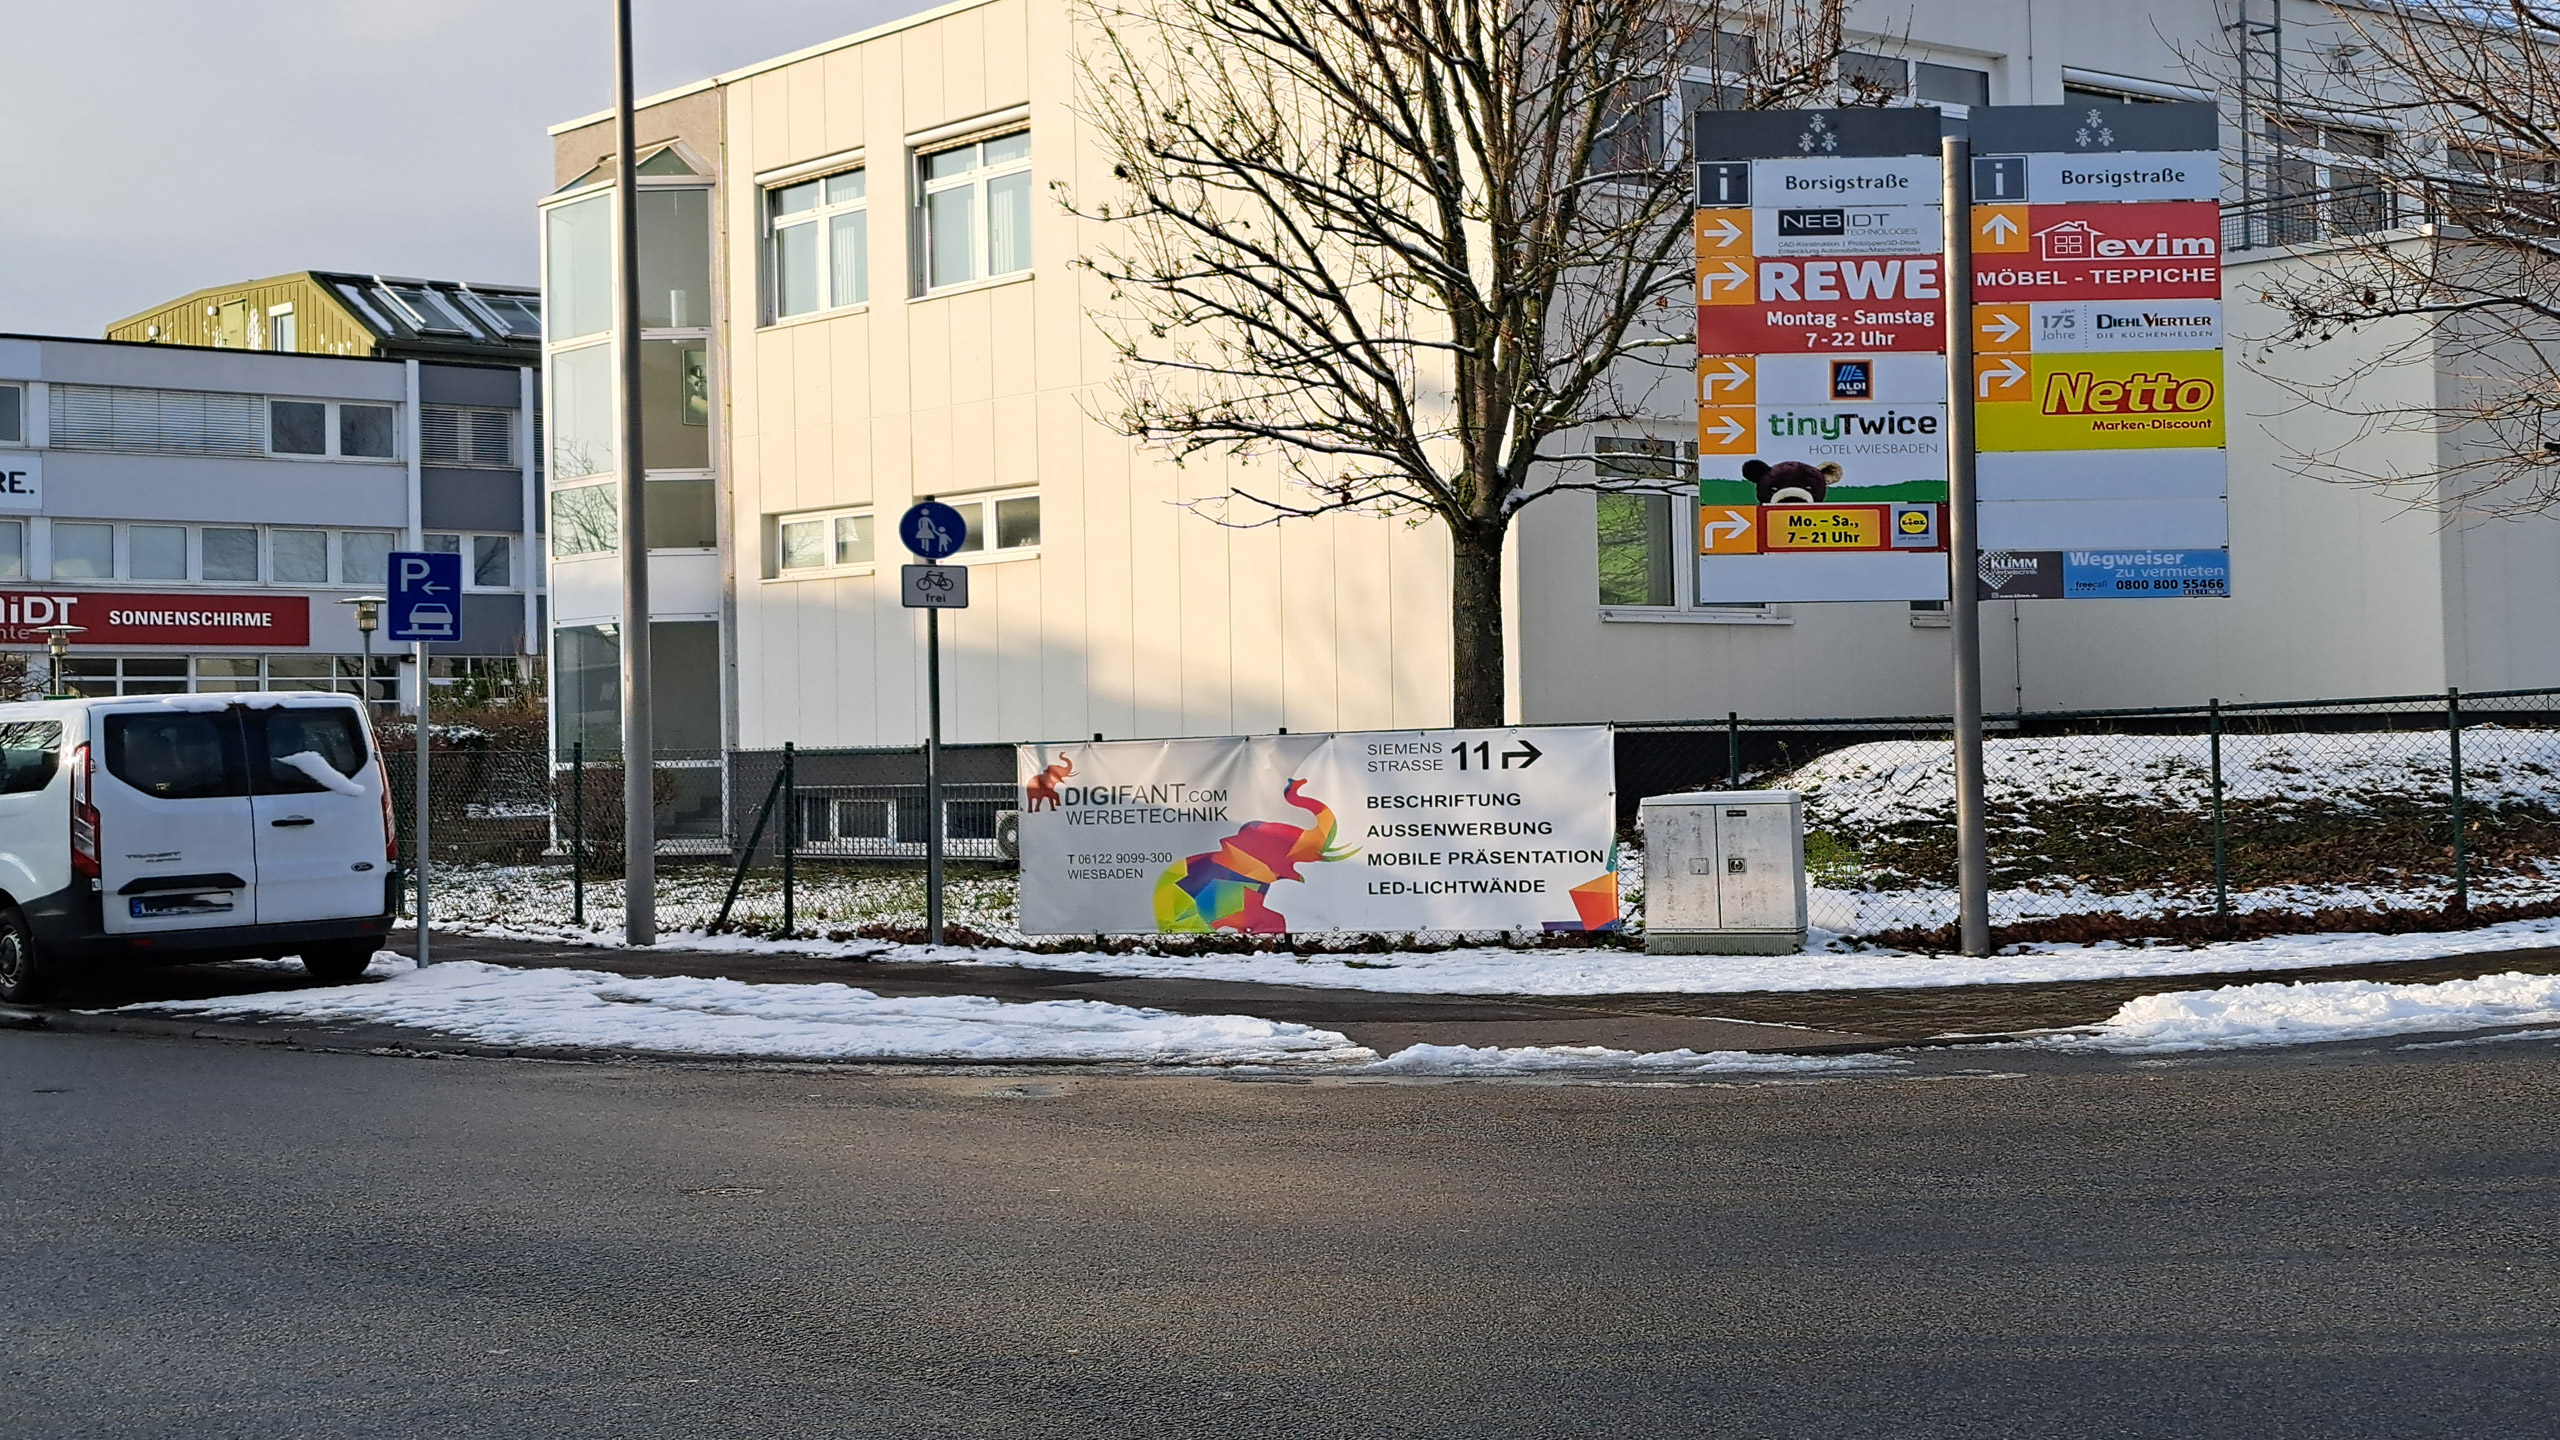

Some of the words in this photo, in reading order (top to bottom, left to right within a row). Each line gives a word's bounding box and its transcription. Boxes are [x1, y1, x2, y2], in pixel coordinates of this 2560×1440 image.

[1785, 173, 1909, 193] Borsigstraße
[2061, 167, 2186, 188] Borsigstraße
[1845, 228, 1918, 236] TECHNOLOGIES
[2096, 233, 2216, 257] evim
[1759, 259, 1941, 302] REWE
[1976, 268, 2068, 287] MÖBEL
[2089, 267, 2217, 284] TEPPICHE
[1767, 310, 1837, 329] Montag
[1854, 309, 1935, 328] Samstag
[2041, 314, 2076, 329] 175
[1806, 333, 1818, 348] 7
[1831, 331, 1855, 347] 22
[1861, 330, 1896, 347] Uhr
[2041, 330, 2076, 341] Jahre
[2096, 332, 2115, 340] DIE
[2121, 330, 2213, 339] KÜCHENHELDEN
[1837, 382, 1867, 390] ALDI
[2042, 371, 2216, 416] Netto
[1768, 410, 1938, 440] tinyTwice
[2092, 418, 2213, 431] Marken-Discount
[1809, 444, 1852, 455] HOTEL
[1855, 443, 1938, 454] WIESBADEN
[1788, 515, 1818, 527] Mo.
[1832, 515, 1860, 529] Sa.,
[1787, 532, 1797, 544] 7
[1812, 532, 1828, 543] 21
[1832, 531, 1860, 543] Uhr
[2069, 550, 2185, 570] Wegweiser
[400, 558, 431, 592] P
[2115, 568, 2135, 578] zu
[2141, 564, 2225, 577] vermieten
[2116, 579, 2149, 590] 0800
[2153, 579, 2179, 589] 800
[2182, 578, 2225, 589] 55466
[926, 593, 946, 603] frei
[108, 609, 273, 628] SONNENSCHIRME
[1367, 742, 1443, 756] SIEMENS
[1451, 740, 1490, 771] 11
[1367, 759, 1444, 773] STRASSE
[1366, 792, 1522, 809] BESCHRIFTUNG
[1065, 805, 1229, 826] WERBETECHNIK
[1366, 821, 1553, 838] AUSSENWERBUNG
[1067, 854, 1075, 865] T
[1078, 853, 1113, 865] 06122
[1116, 852, 1173, 864] 9099-300
[1367, 852, 1442, 867] MOBILE
[1449, 849, 1604, 865] PRÄSENTATION
[1067, 868, 1144, 880] WIESBADEN
[1367, 877, 1547, 895] LED-LICHTWÄNDE
